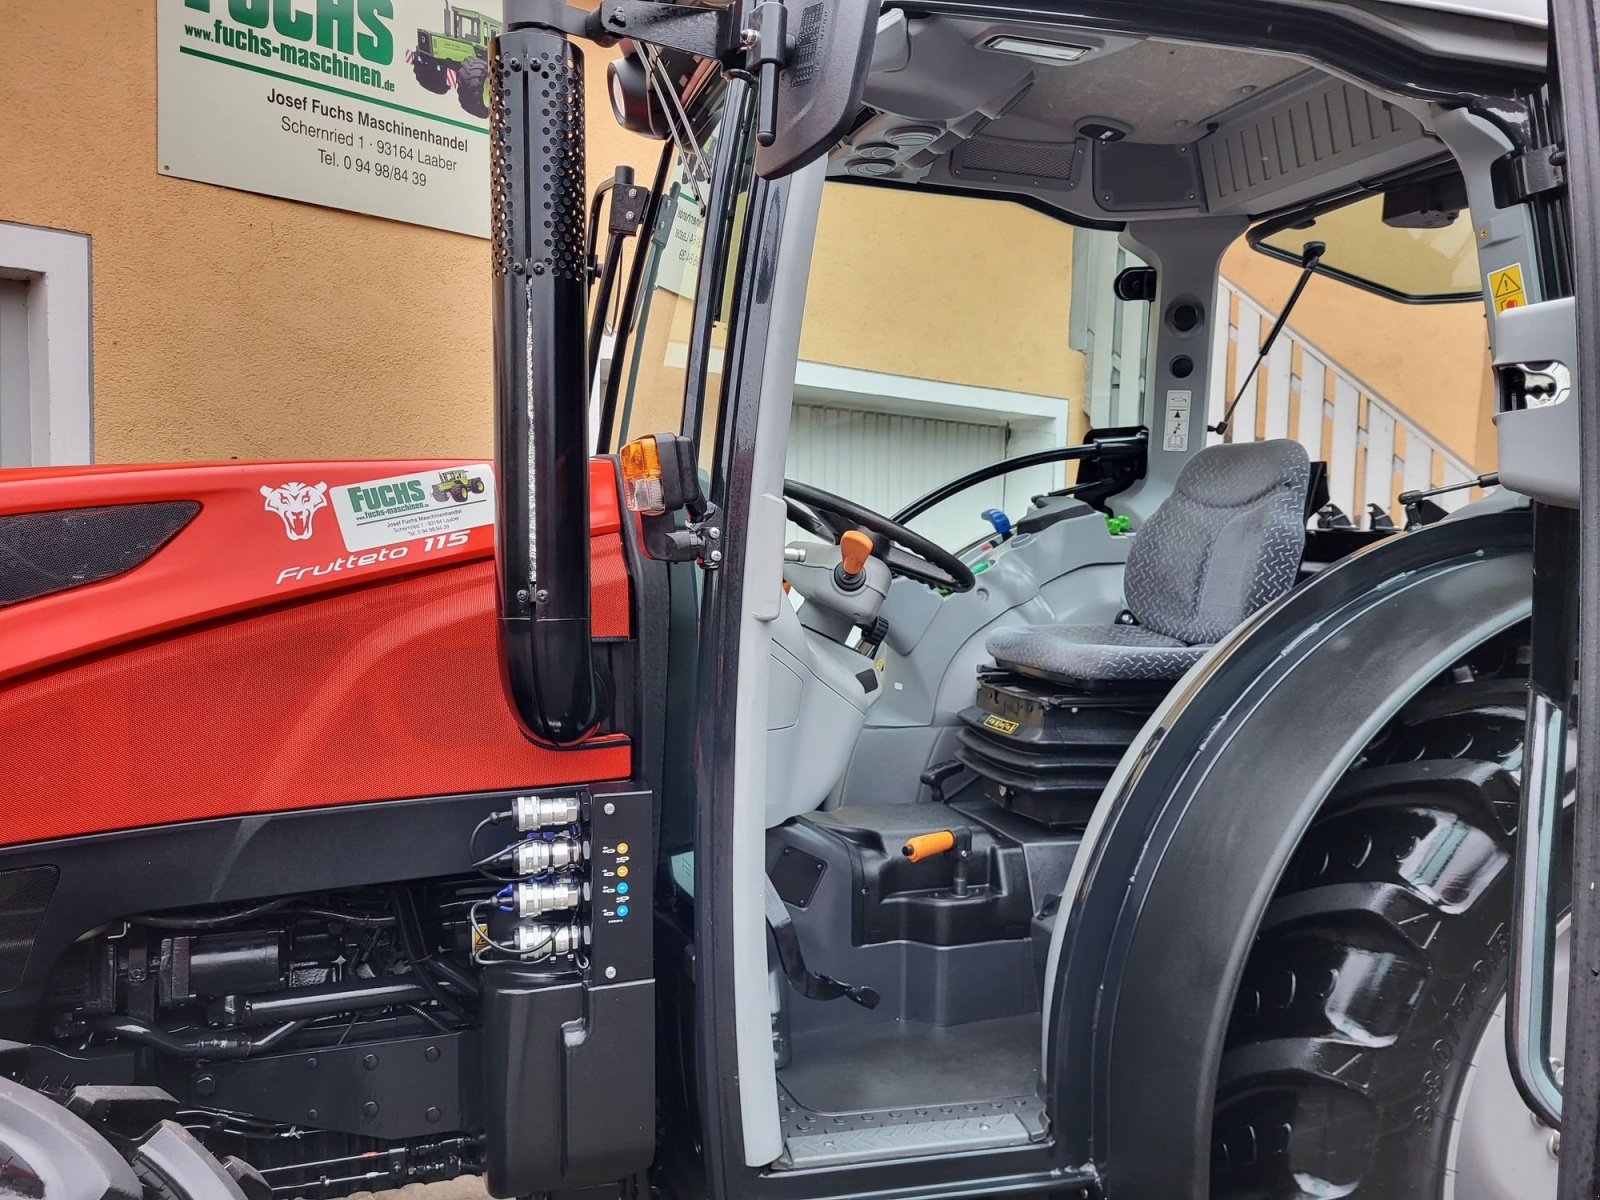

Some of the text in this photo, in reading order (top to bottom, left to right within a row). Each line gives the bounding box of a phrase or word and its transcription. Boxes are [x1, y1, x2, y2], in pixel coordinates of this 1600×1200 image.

[184, 19, 395, 92] www.fuchs-maschinen.de
[267, 88, 468, 152] Josef Fuchs Maschinenhandel
[281, 116, 354, 147] Schernried
[358, 136, 364, 149] 1
[376, 140, 413, 161] 93164
[417, 149, 457, 171] Laaber
[318, 148, 427, 187] Tel. 0 94 98/84 39
[347, 479, 425, 513] FUCHS
[275, 529, 471, 585] Frutteto 115
